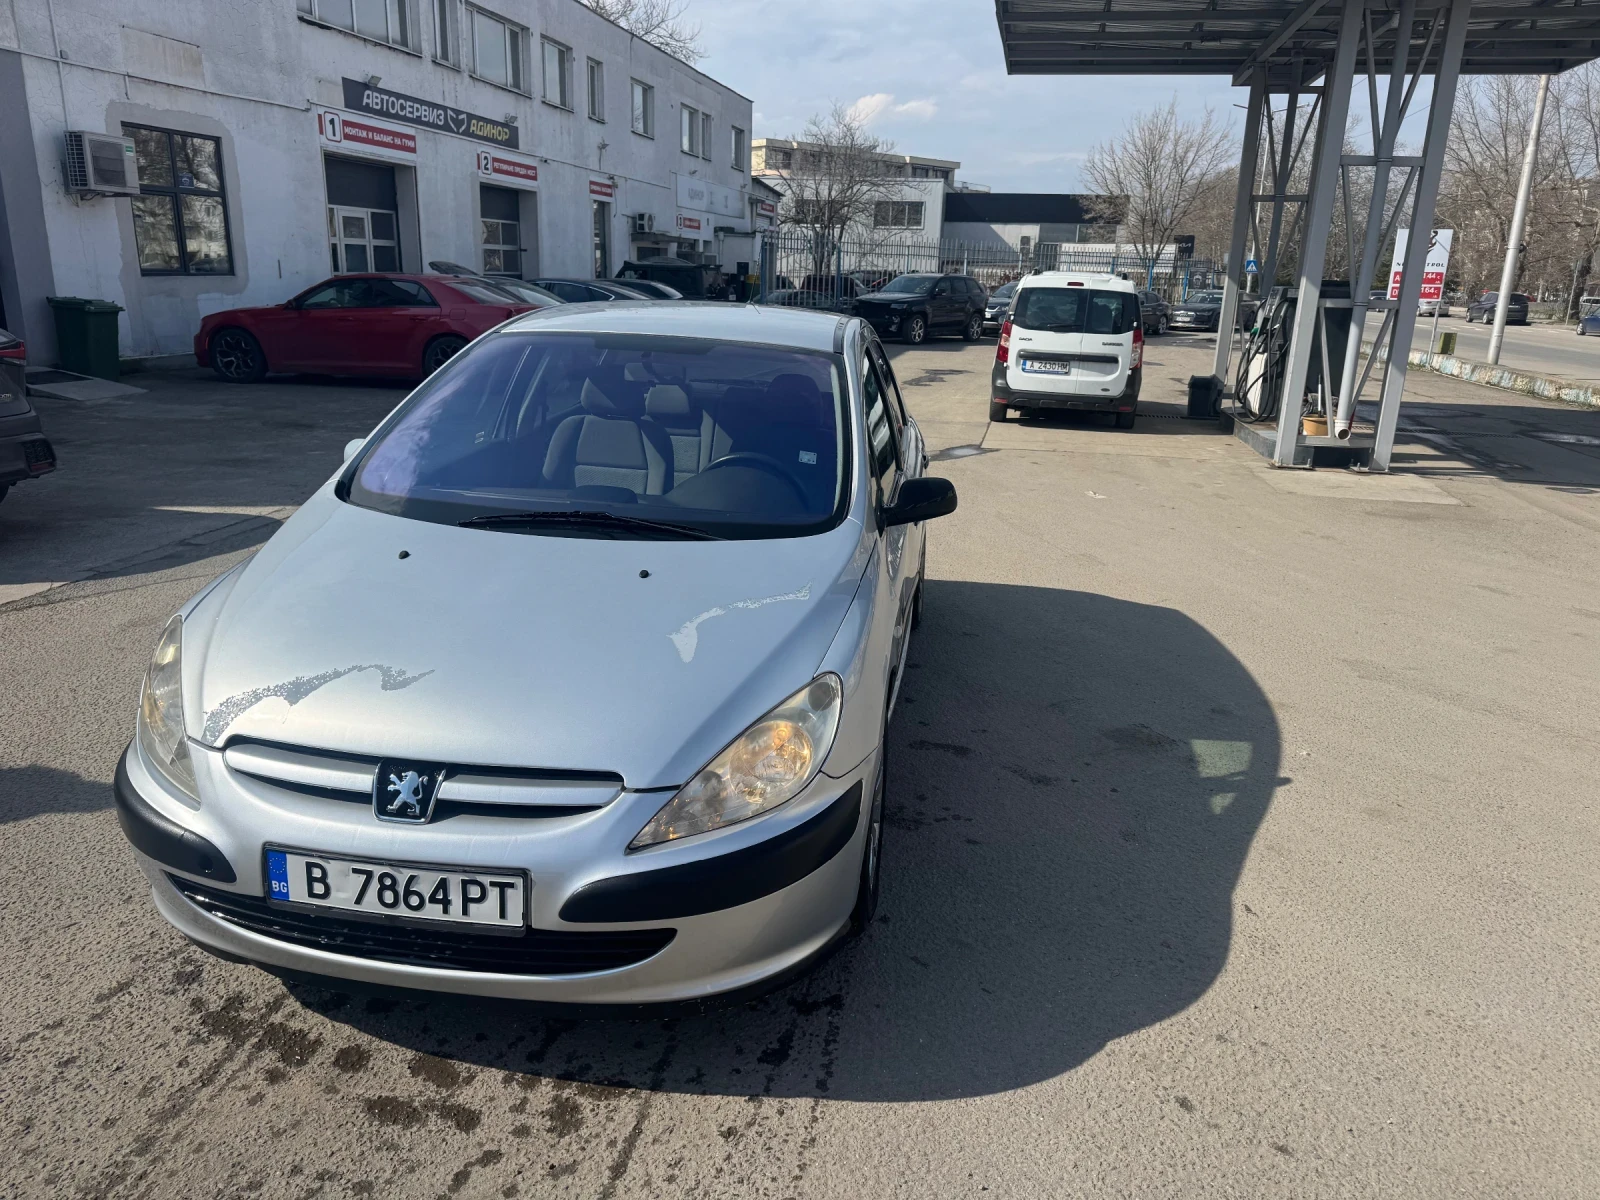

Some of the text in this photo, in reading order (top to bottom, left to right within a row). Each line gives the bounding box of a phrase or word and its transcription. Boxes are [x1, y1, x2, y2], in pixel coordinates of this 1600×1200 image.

[362, 89, 510, 141] АВТОСЕРВИЗ АДИНОР
[328, 117, 415, 148] 1 МОНТАЖ И БАЛАНС НА ГУМИ
[483, 155, 490, 171] 2
[1030, 360, 1035, 369] A
[271, 880, 288, 893] BG
[304, 861, 331, 901] B
